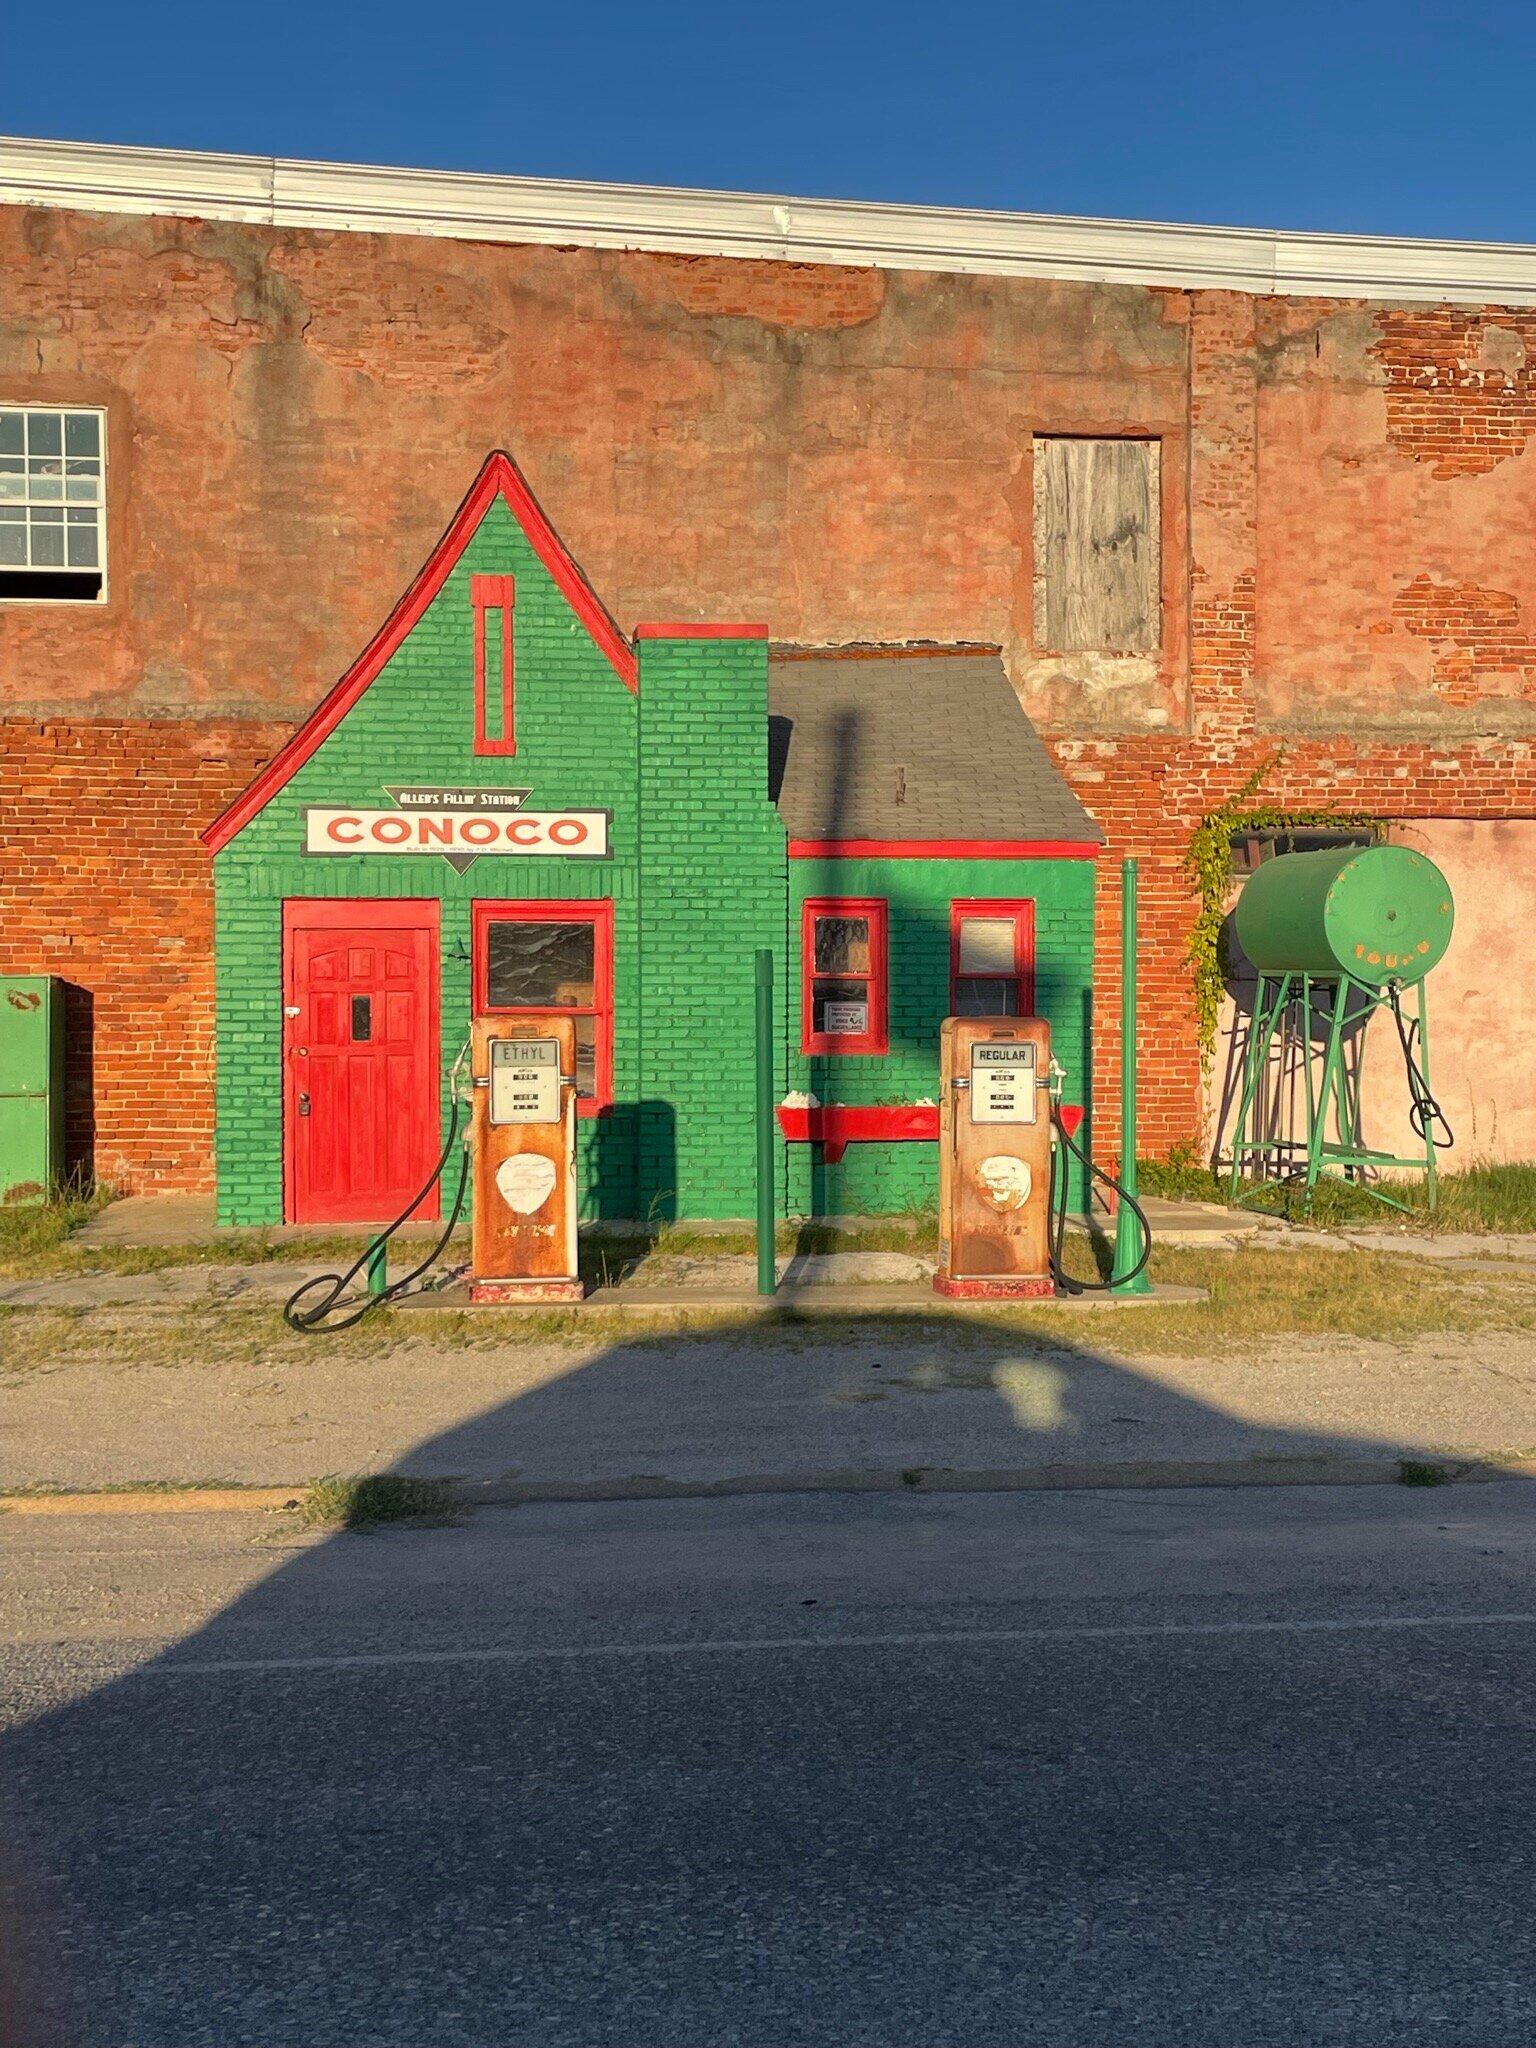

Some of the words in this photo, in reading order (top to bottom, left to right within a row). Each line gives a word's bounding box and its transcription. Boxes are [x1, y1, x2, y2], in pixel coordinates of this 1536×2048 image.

[326, 816, 588, 846] CONOCO
[503, 1047, 546, 1060] ETHYL
[979, 1050, 1026, 1061] REGULAR
